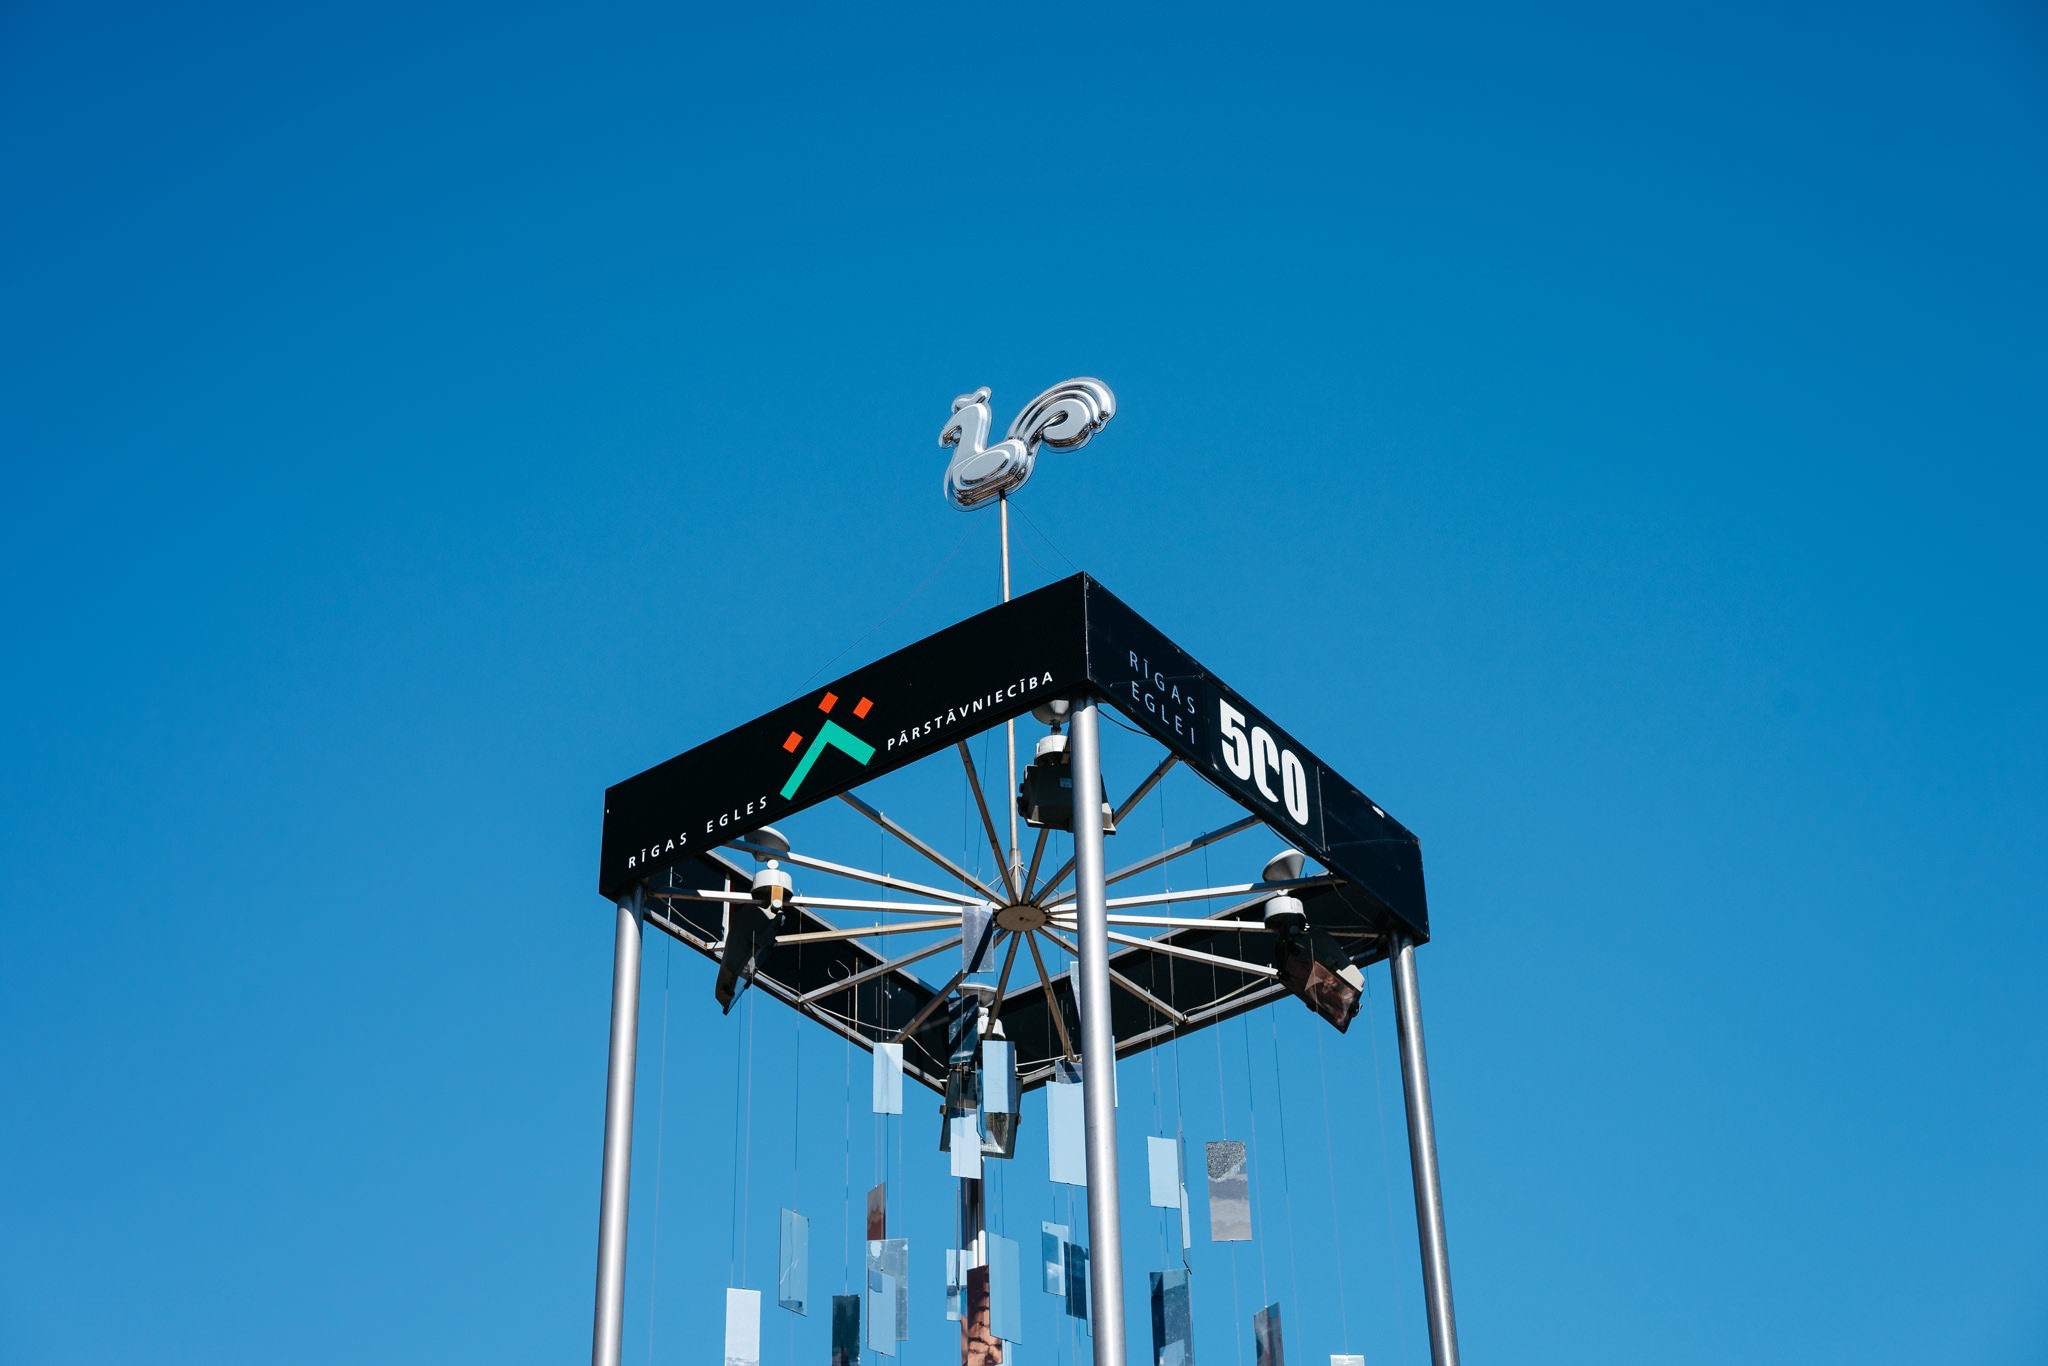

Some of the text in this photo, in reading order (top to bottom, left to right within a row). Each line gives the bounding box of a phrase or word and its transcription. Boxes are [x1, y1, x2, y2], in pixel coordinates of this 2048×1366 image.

[1129, 650, 1196, 714] RĪGAS
[1131, 680, 1195, 745] EGLEI
[628, 671, 1053, 869] RĪGAS EGLES PĀRSTĀVNIECĪBA
